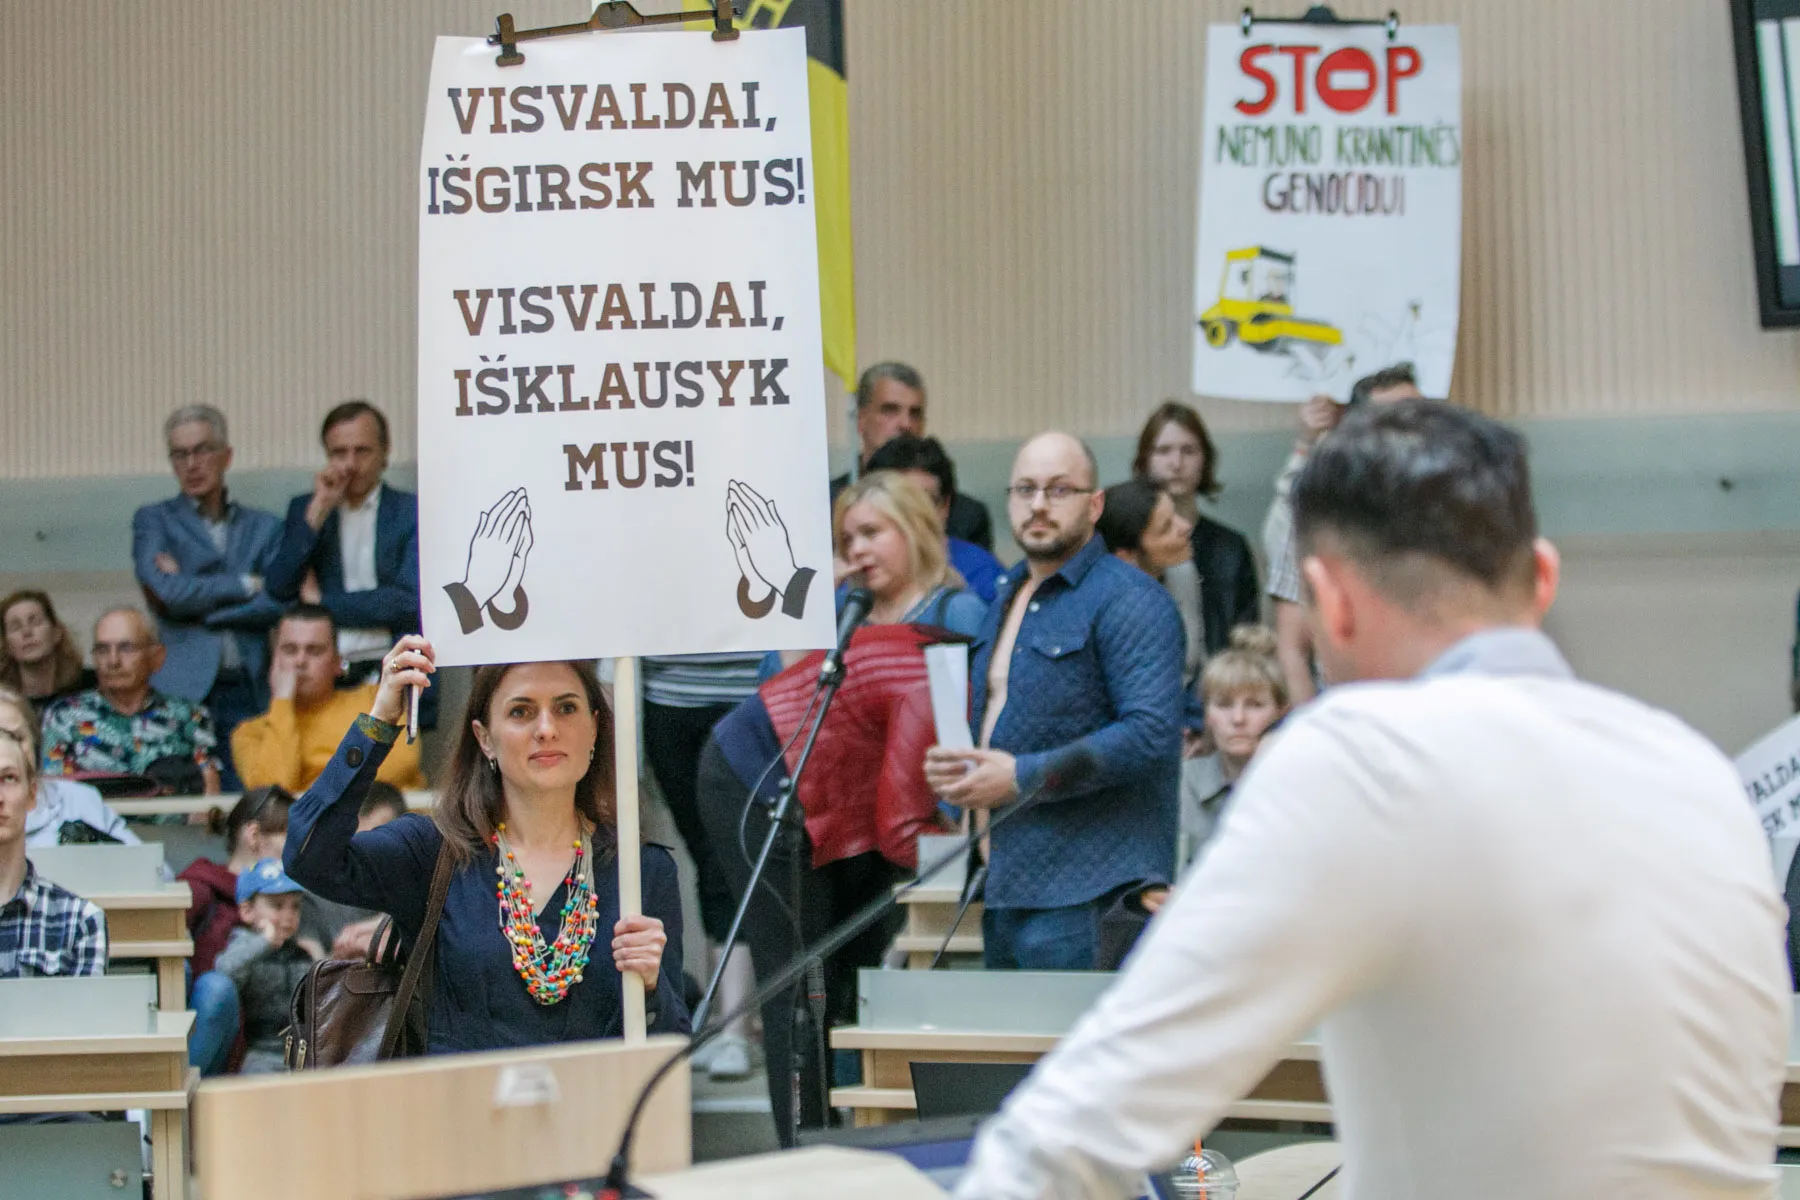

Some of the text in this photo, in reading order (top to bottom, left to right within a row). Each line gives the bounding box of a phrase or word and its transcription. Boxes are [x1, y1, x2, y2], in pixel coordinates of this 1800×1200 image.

[1234, 43, 1424, 117] STOP
[447, 81, 777, 135] VISVALDAI,
[1216, 124, 1322, 168] NEMUNO
[427, 153, 805, 215] IŠGIRSK MUS!
[1262, 171, 1406, 217] GENOCIDUI
[452, 280, 785, 337] VISVALDAI,
[453, 354, 790, 417] IŠKLAUSYK
[562, 439, 695, 492] MUS!
